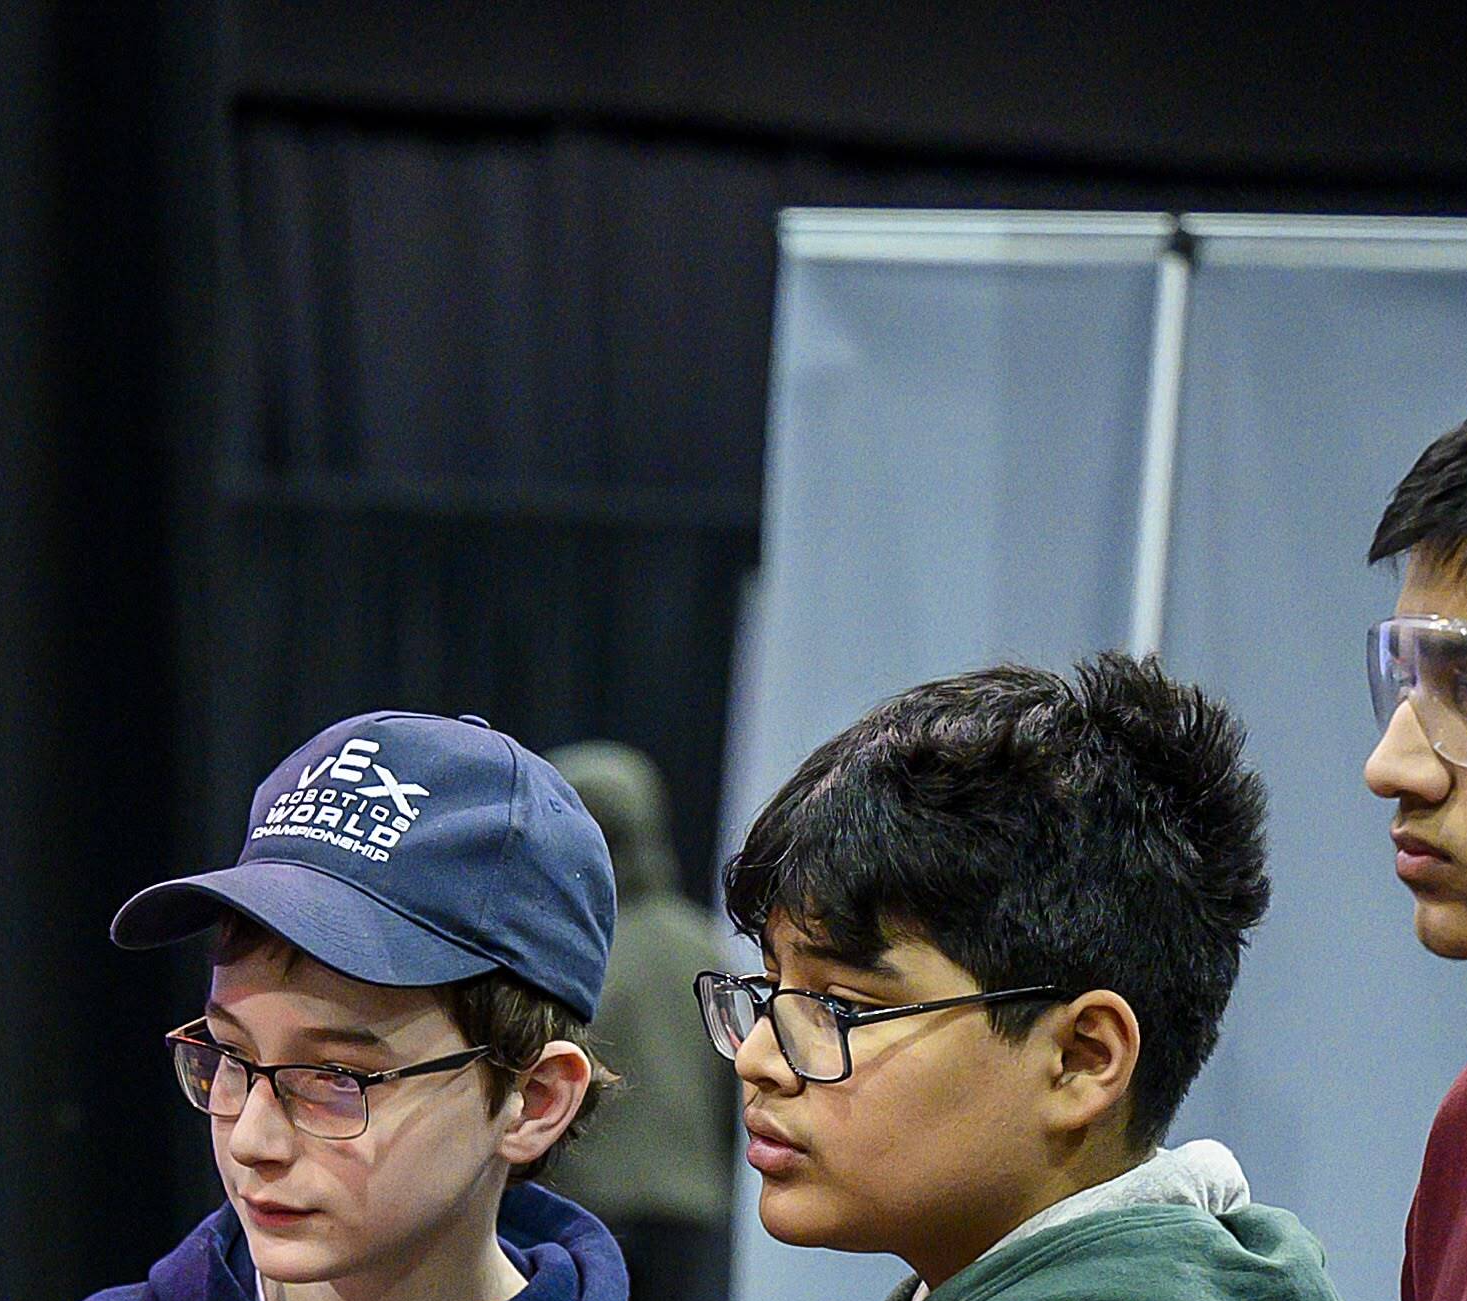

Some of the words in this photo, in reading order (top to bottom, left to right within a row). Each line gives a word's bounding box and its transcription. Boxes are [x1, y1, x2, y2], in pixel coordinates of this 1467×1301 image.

[297, 738, 430, 821] VEX
[266, 804, 401, 848] WORLD
[274, 788, 411, 832] ROBOTICS
[251, 824, 390, 863] CHAMPIONSHIP
